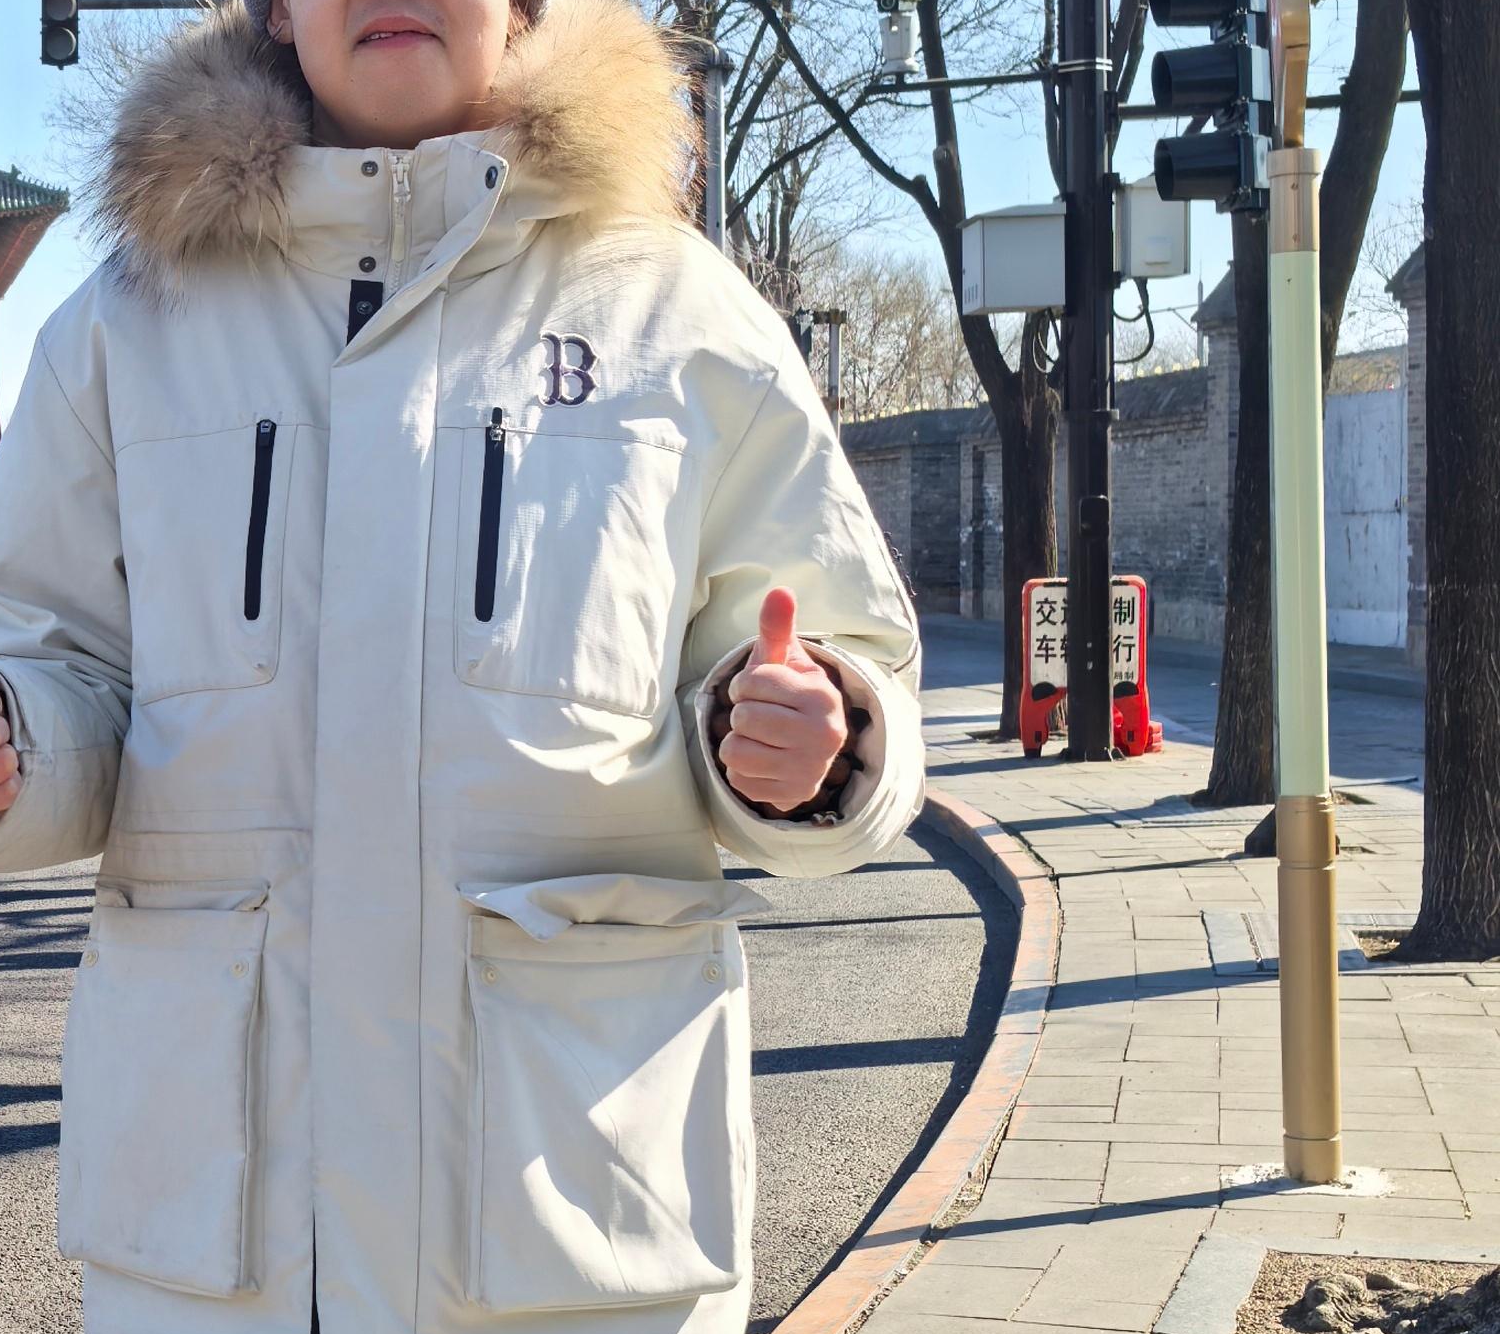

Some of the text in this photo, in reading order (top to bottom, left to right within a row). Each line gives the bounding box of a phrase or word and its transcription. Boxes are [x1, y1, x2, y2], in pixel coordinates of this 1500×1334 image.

[539, 331, 600, 407] B
[1035, 596, 1135, 626] 交制
[1035, 634, 1135, 664] 车行
